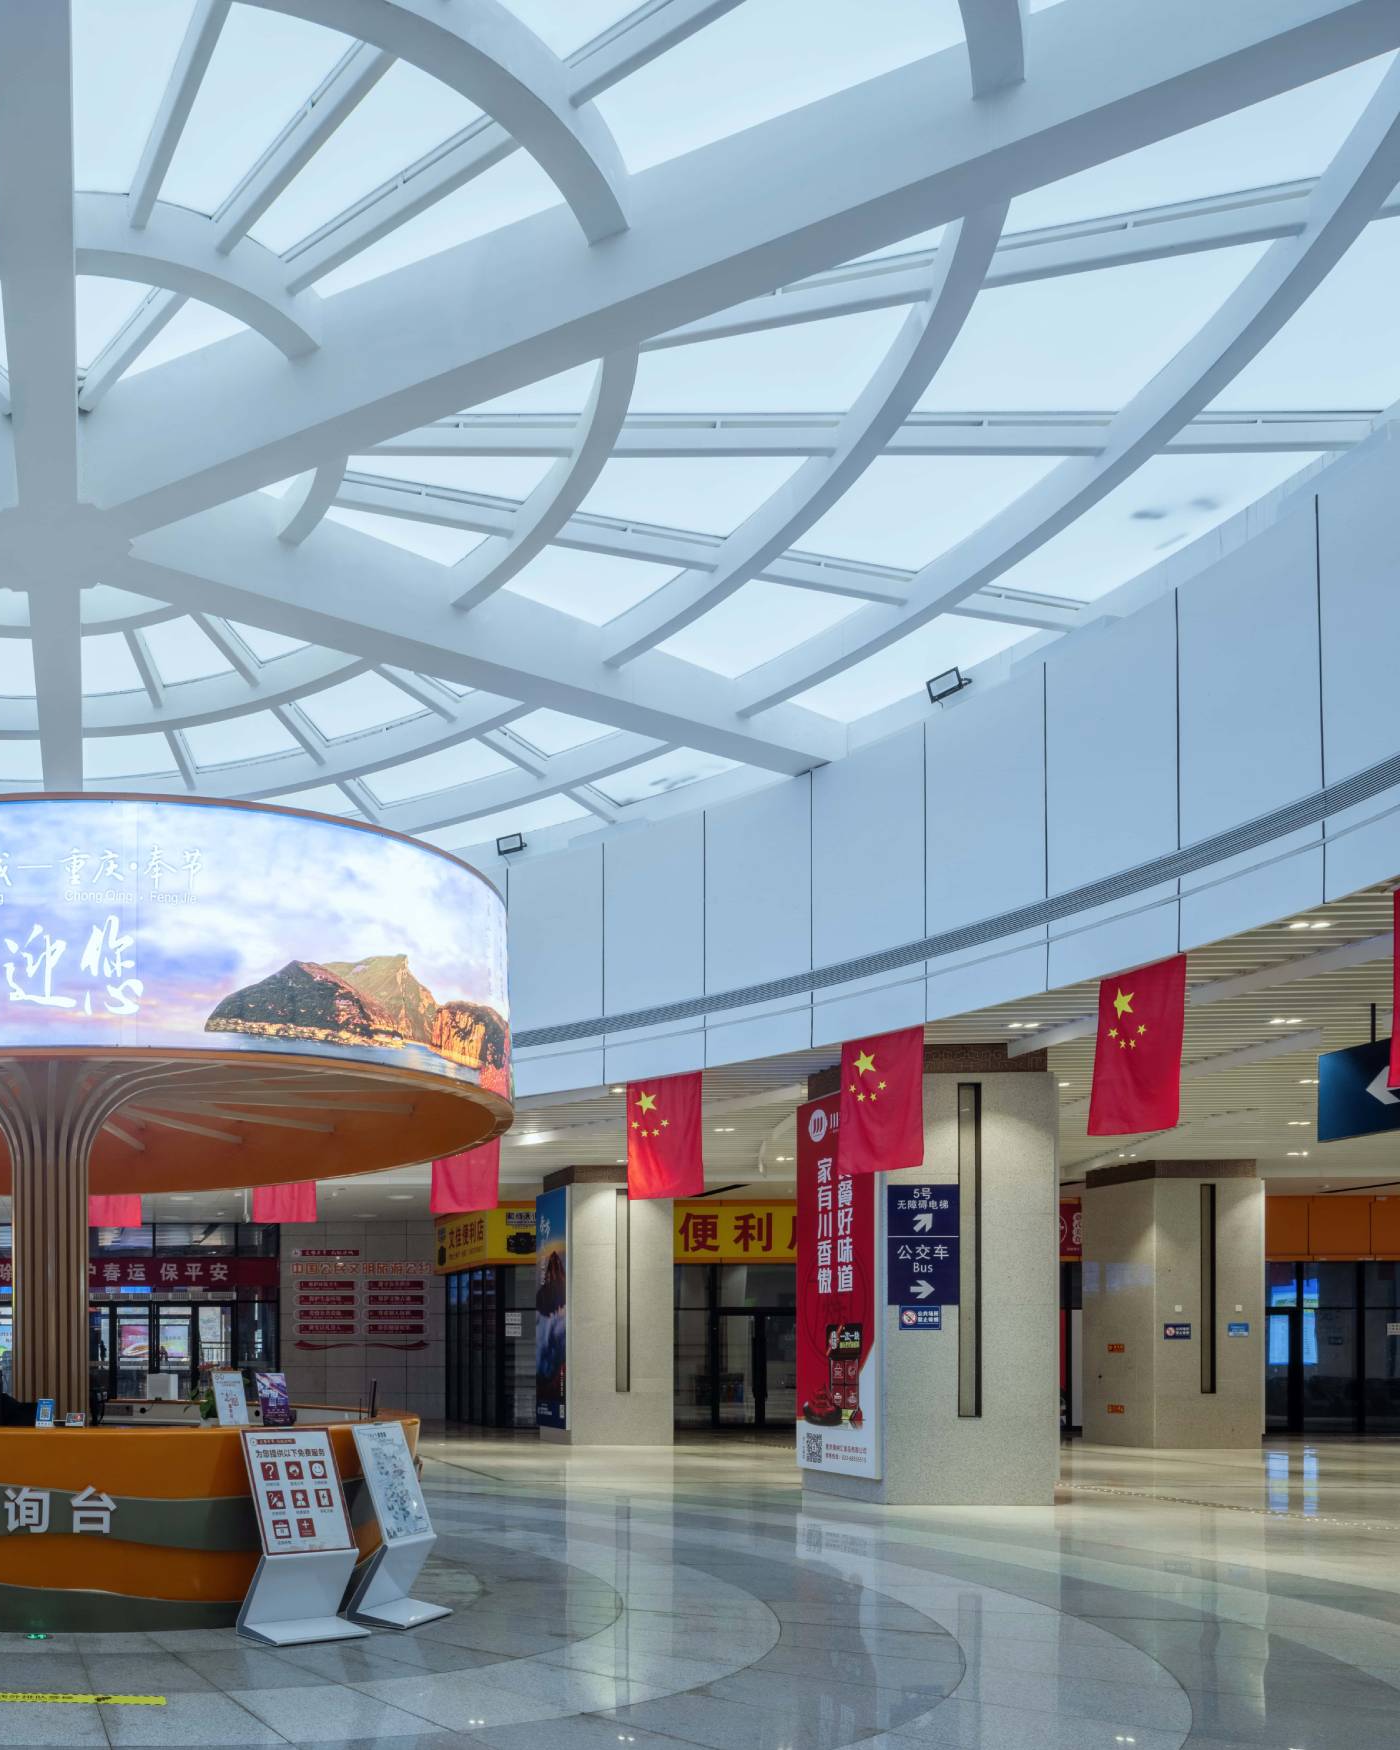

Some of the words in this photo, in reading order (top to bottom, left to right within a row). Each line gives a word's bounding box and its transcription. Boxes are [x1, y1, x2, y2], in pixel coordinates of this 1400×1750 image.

[64, 889, 104, 904] Chong
[150, 890, 179, 906] Feng
[181, 891, 200, 905] Jie
[913, 1187, 932, 1200] 5号
[896, 1199, 950, 1210] 无障碍电梯
[817, 1157, 833, 1294] 家有川香傲
[837, 1172, 854, 1293] 餐好味道
[896, 1244, 950, 1261] 公交车
[160, 1263, 229, 1281] 保平安
[912, 1262, 934, 1273] Bus
